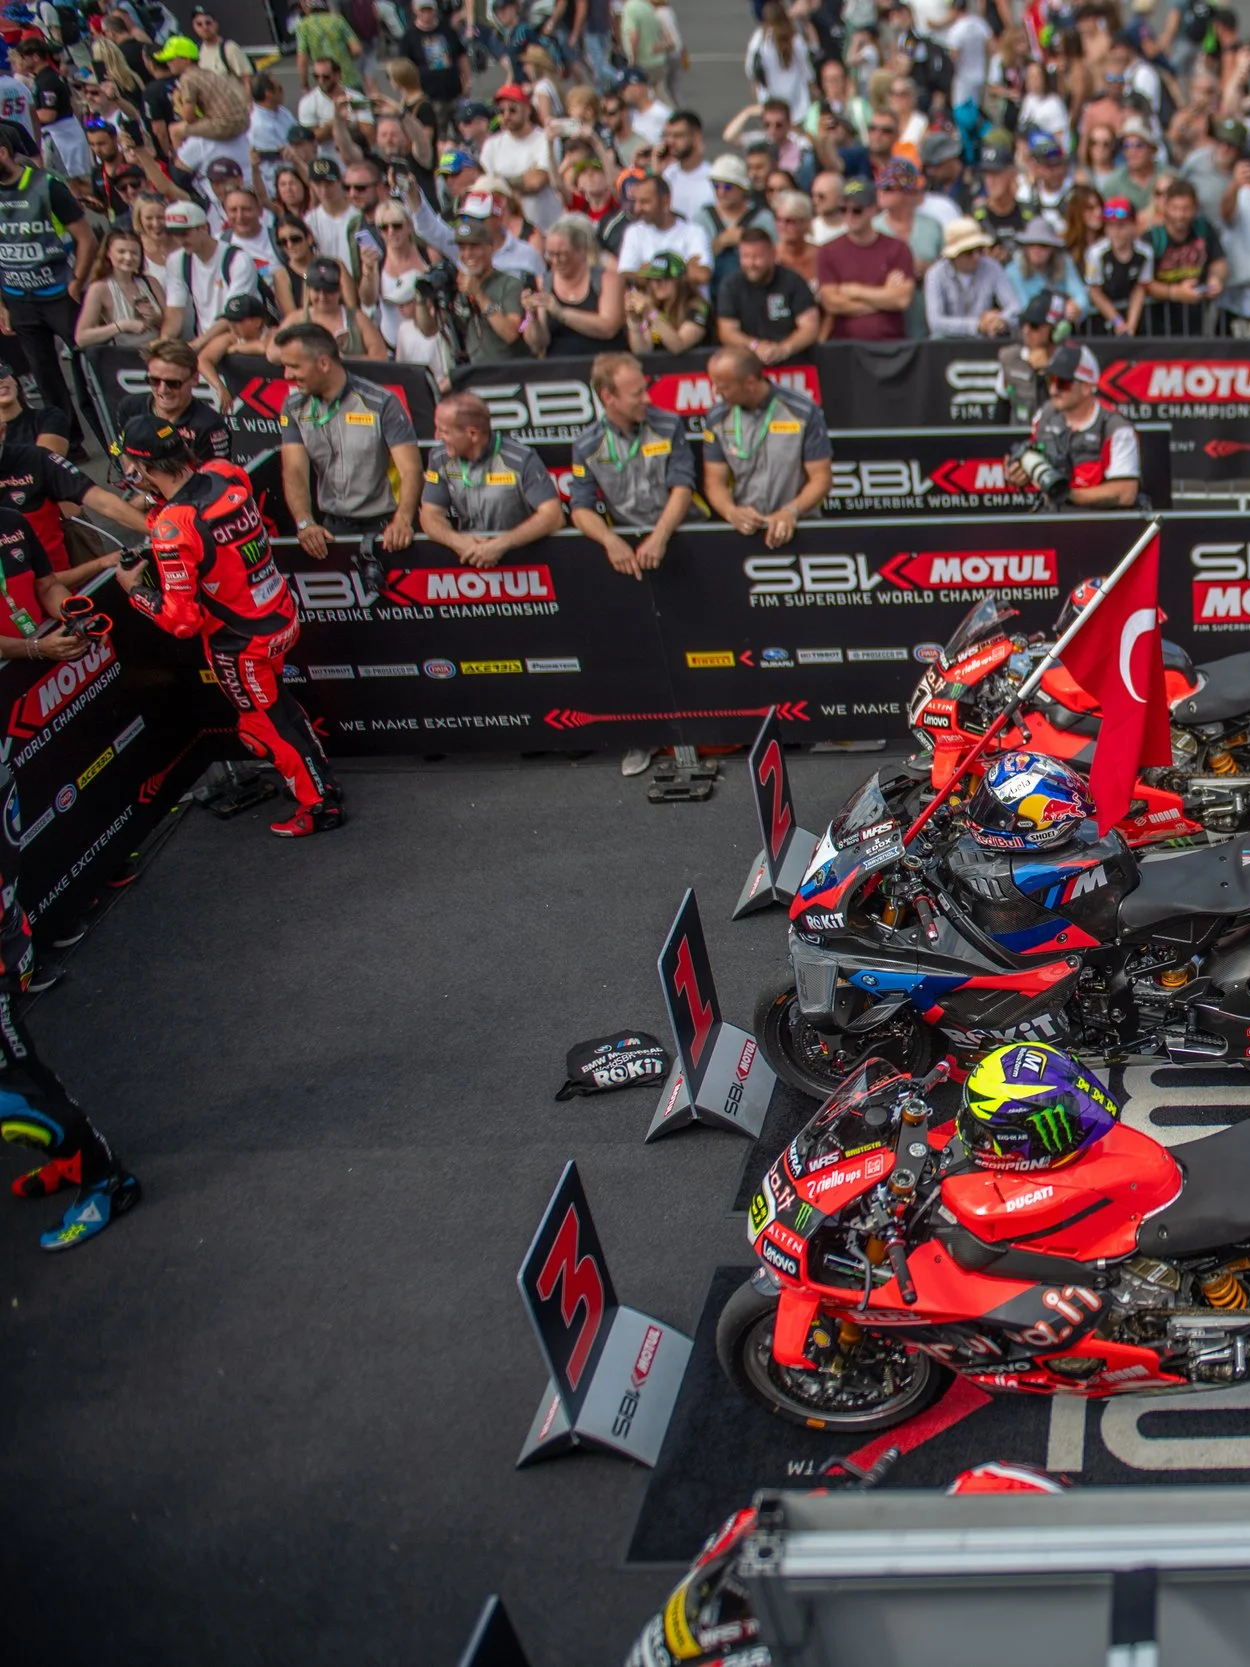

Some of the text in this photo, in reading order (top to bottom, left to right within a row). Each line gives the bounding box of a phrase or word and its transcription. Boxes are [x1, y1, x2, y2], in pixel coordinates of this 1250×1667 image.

[845, 497, 921, 511] SUPERBIKE
[927, 493, 979, 508] WORLD
[426, 570, 549, 600] MOTUL
[743, 553, 1053, 593] SBK MOTUL
[750, 586, 1060, 608] FIM SUPERBIKE WORLD CHAMPIONSHIP
[299, 600, 560, 624] UPERBIKE WORLD CHAMPIONSHIP
[1193, 624, 1210, 632] FIM
[14, 661, 122, 770] WORLD CHAMPIONSHIP
[821, 701, 901, 715] WE MAKE
[340, 713, 531, 732] WE MAKE EXCITEMENT
[923, 713, 949, 728] Lenovo
[759, 739, 792, 862] 2
[862, 820, 894, 840] WRS
[972, 830, 1025, 849] Red Bull
[1029, 830, 1057, 843] SHOEI
[40, 876, 70, 915] MAKE
[70, 804, 134, 878] EXCITEMENT
[805, 912, 847, 930] ROKiT
[673, 934, 715, 1070] 1
[581, 1056, 608, 1074] BMW
[740, 1040, 758, 1074] MOTUL
[592, 1057, 664, 1089] ROKiT
[808, 1151, 841, 1174] WRS
[816, 1168, 862, 1193] riello ups
[1005, 1185, 1055, 1213] DUCATI
[762, 1239, 798, 1276] Lenovo
[535, 1201, 605, 1392] 3
